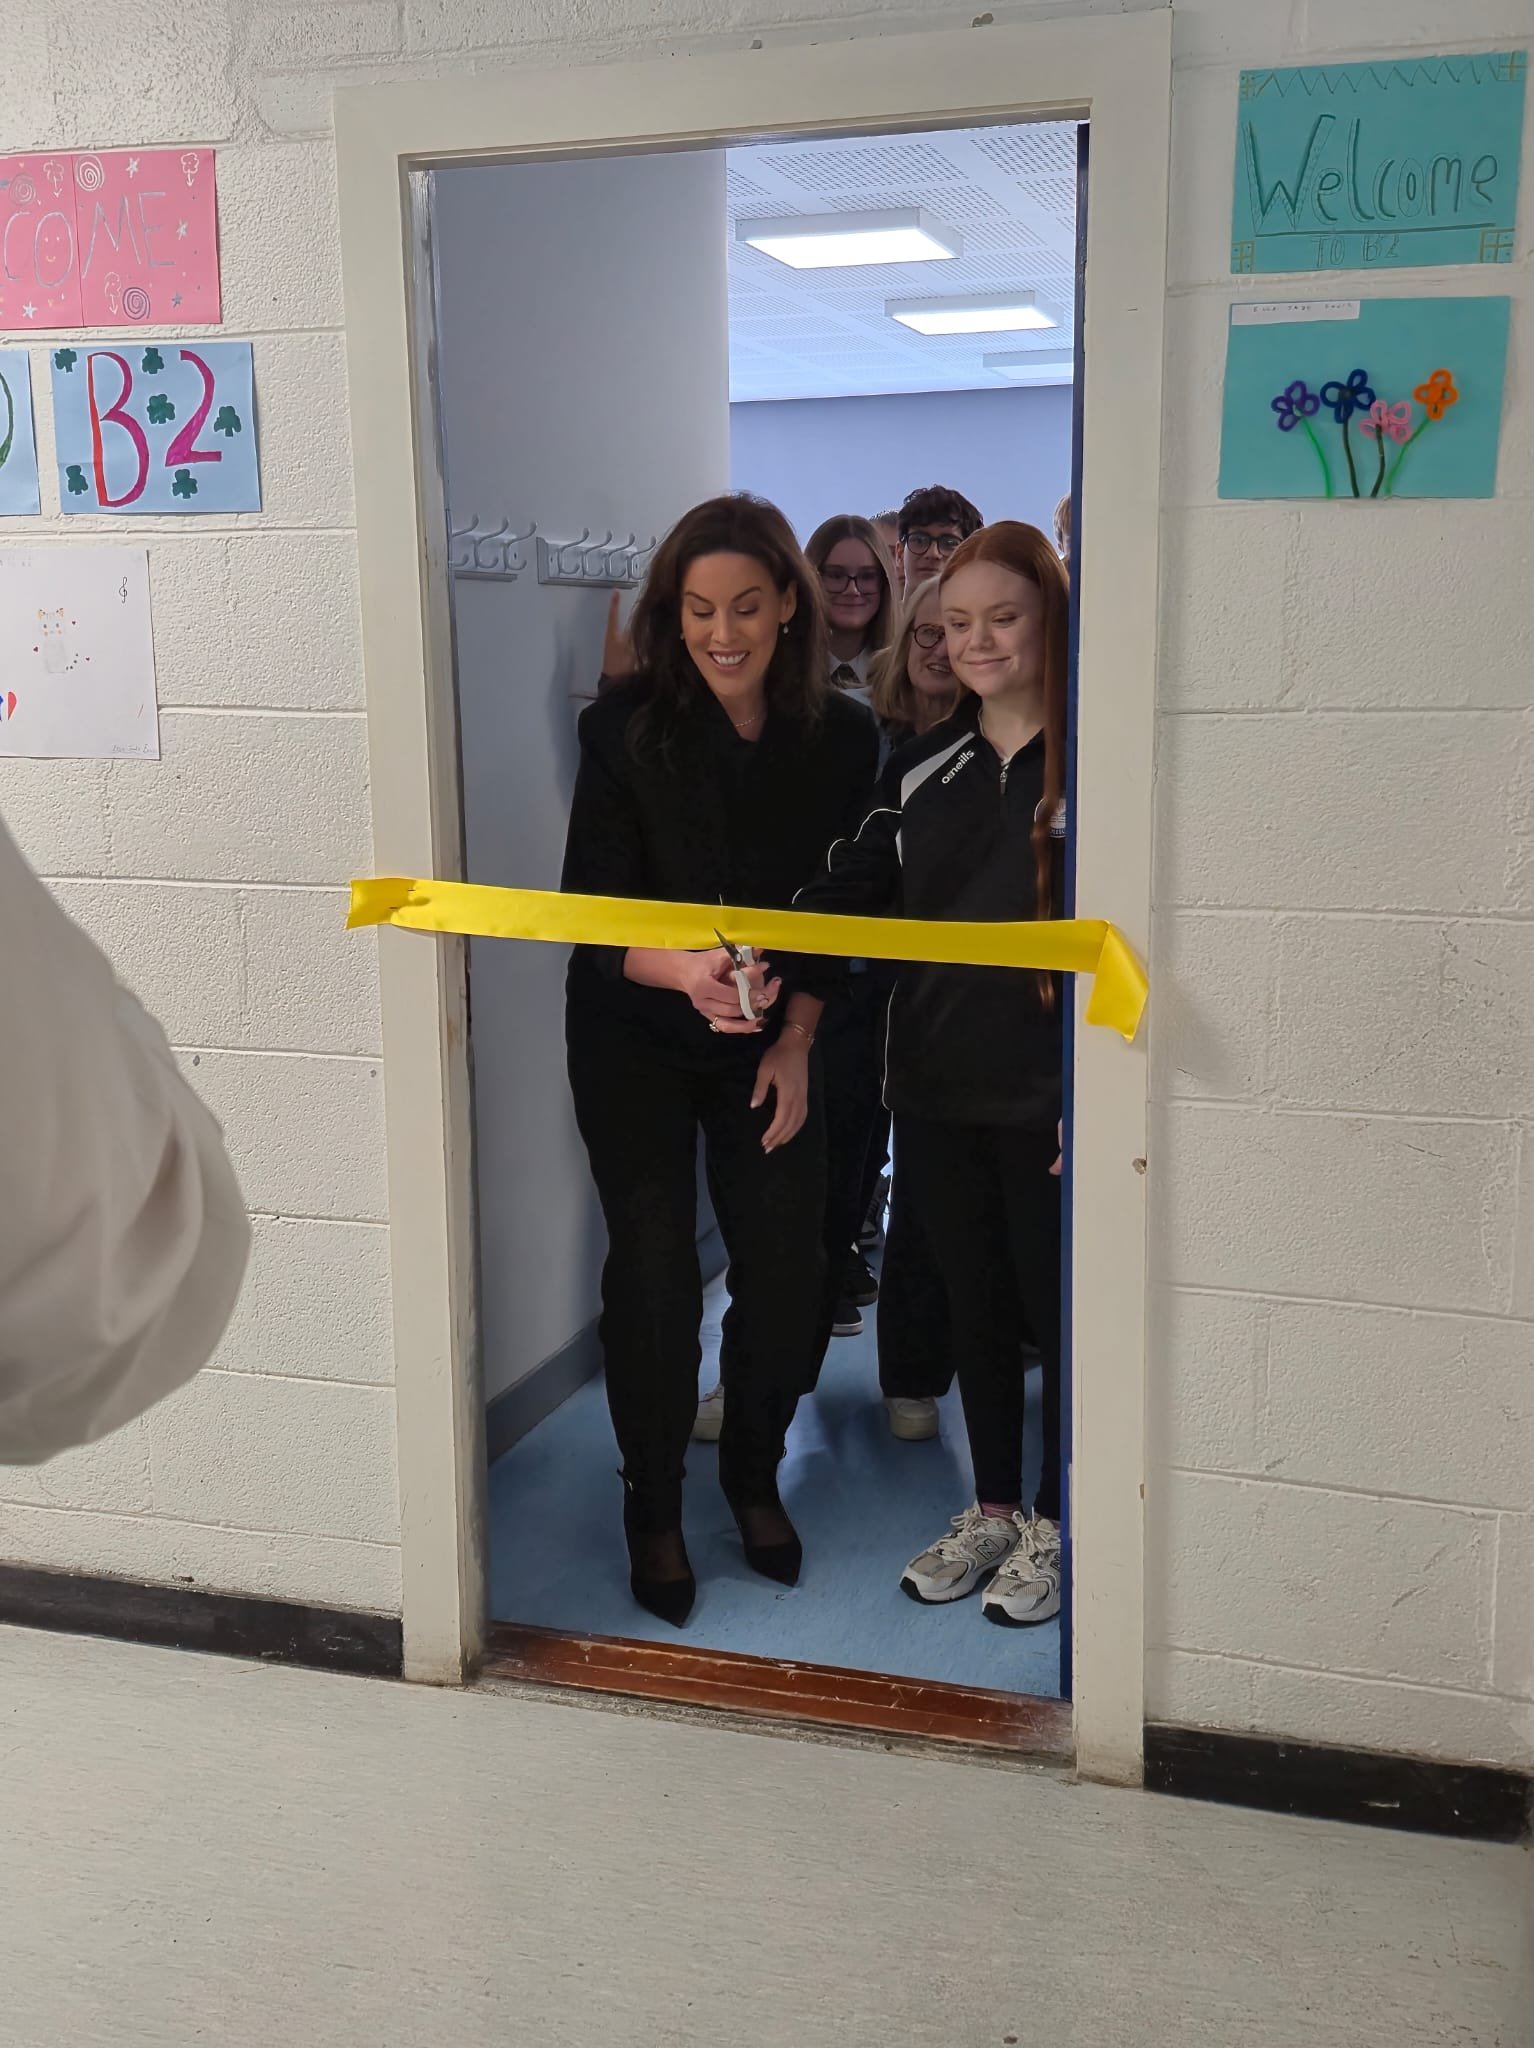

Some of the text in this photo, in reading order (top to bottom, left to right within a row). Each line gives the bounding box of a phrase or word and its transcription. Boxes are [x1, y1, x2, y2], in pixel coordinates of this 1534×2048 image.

[1241, 113, 1499, 232] Welcome
[3, 191, 177, 288] COME
[1311, 233, 1346, 268] TO
[87, 349, 222, 508] B2
